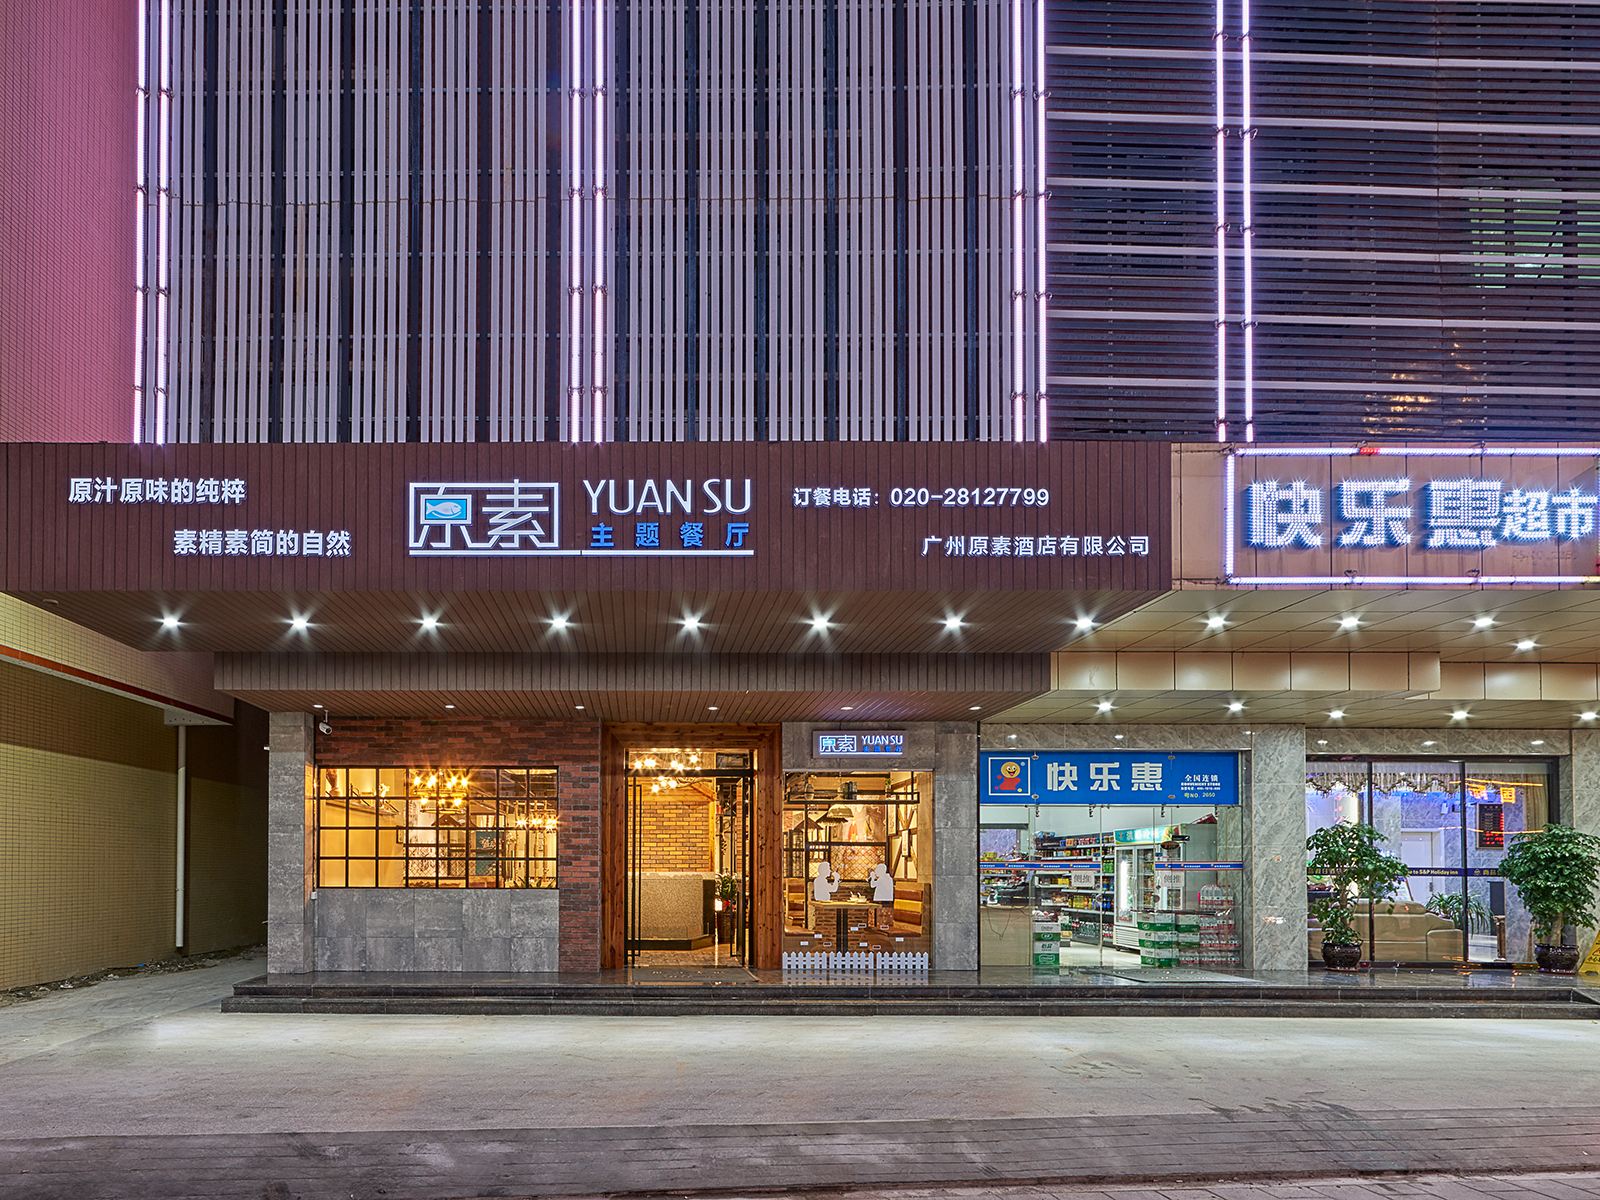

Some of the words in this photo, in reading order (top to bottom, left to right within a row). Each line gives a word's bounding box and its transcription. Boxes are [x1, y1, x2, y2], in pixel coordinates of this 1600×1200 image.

[68, 477, 246, 504] 原汁原味的纯粹
[582, 479, 692, 514] YUAN
[703, 478, 751, 514] SU
[890, 487, 1049, 507] 020-28127799
[173, 529, 352, 556] 素精素简的自然
[590, 521, 749, 548] 主题餐厅
[921, 535, 1149, 557] 广州原素酒店有限公司
[861, 735, 889, 745] YUAN
[890, 735, 904, 745] SU
[1046, 762, 1163, 792] 快乐惠
[1185, 774, 1218, 782] 全国连锁
